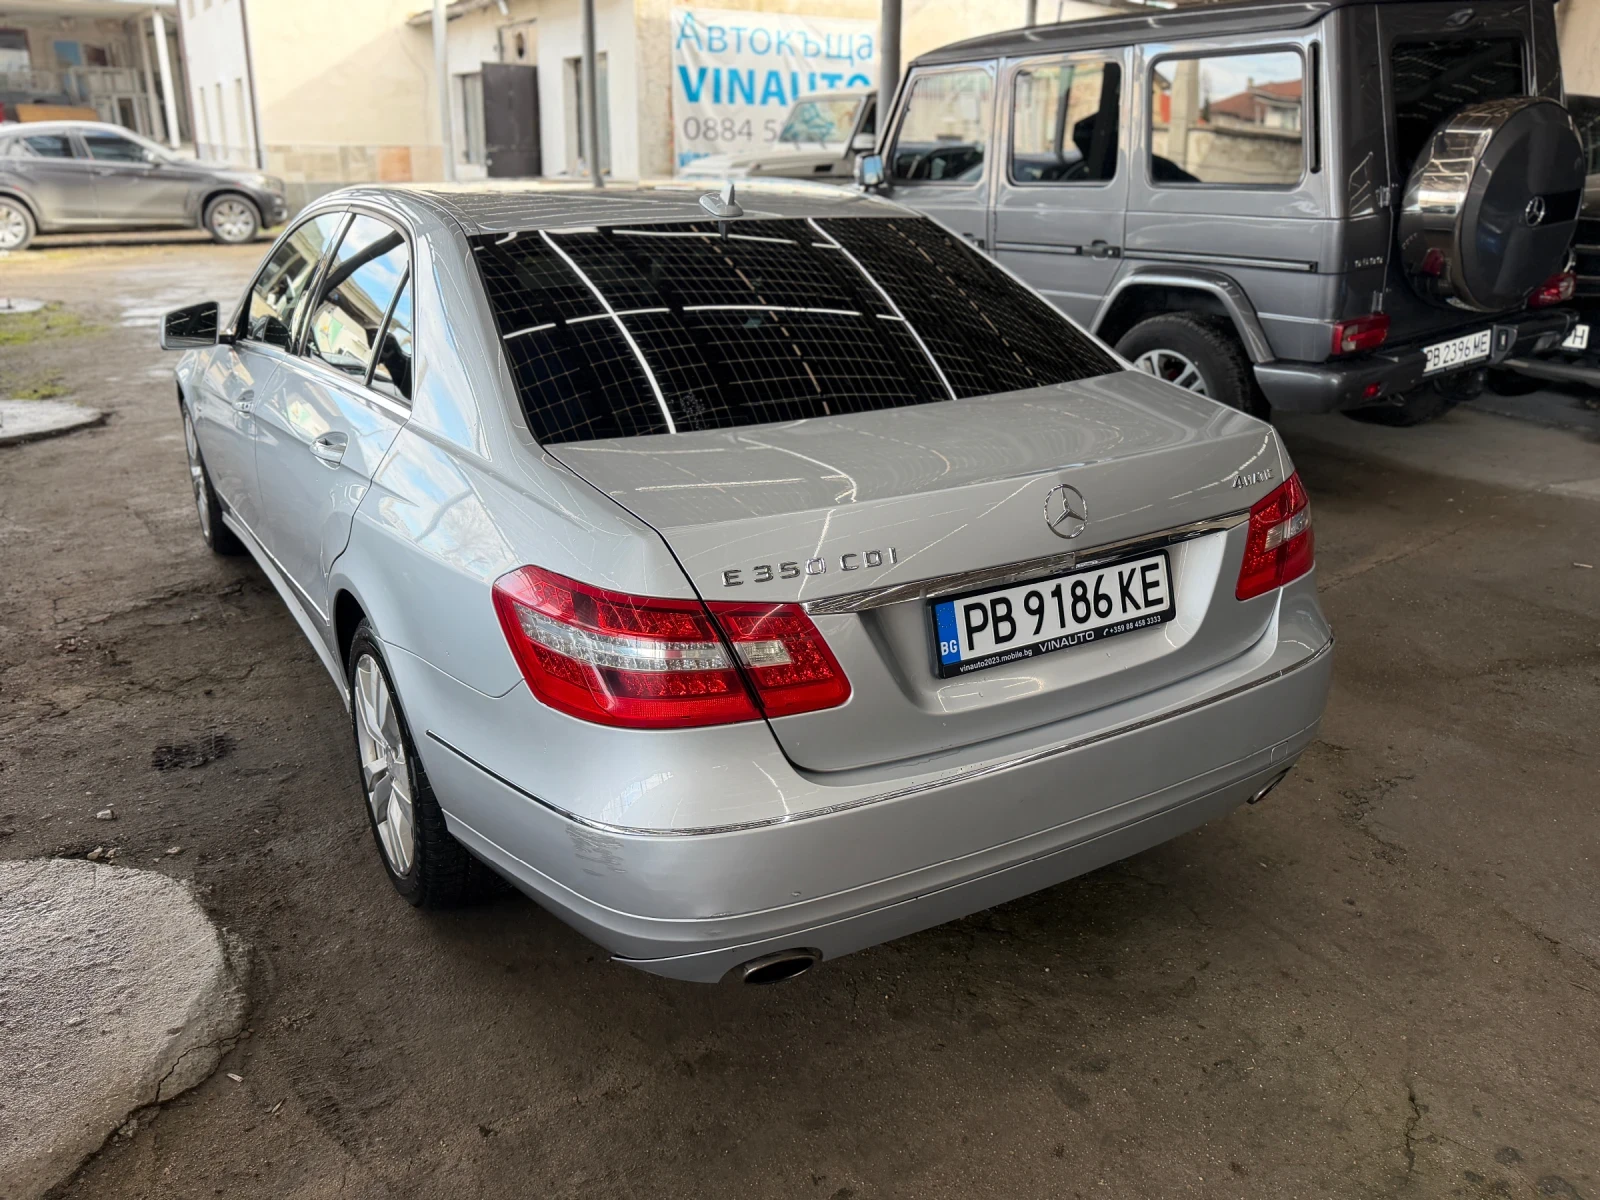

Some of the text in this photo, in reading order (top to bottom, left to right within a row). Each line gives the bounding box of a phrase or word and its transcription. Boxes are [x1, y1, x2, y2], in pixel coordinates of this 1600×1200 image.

[676, 12, 873, 66] Автокъща
[683, 116, 754, 142] 0884
[1427, 347, 1440, 367] PB
[1443, 339, 1470, 364] 2396
[722, 547, 897, 587] E 350 CDI
[963, 562, 1164, 651] PB 9186 KE
[940, 639, 958, 656] BG
[960, 649, 1033, 673] vinauto2023.mobile.bg
[1039, 630, 1095, 653] VINAUTO
